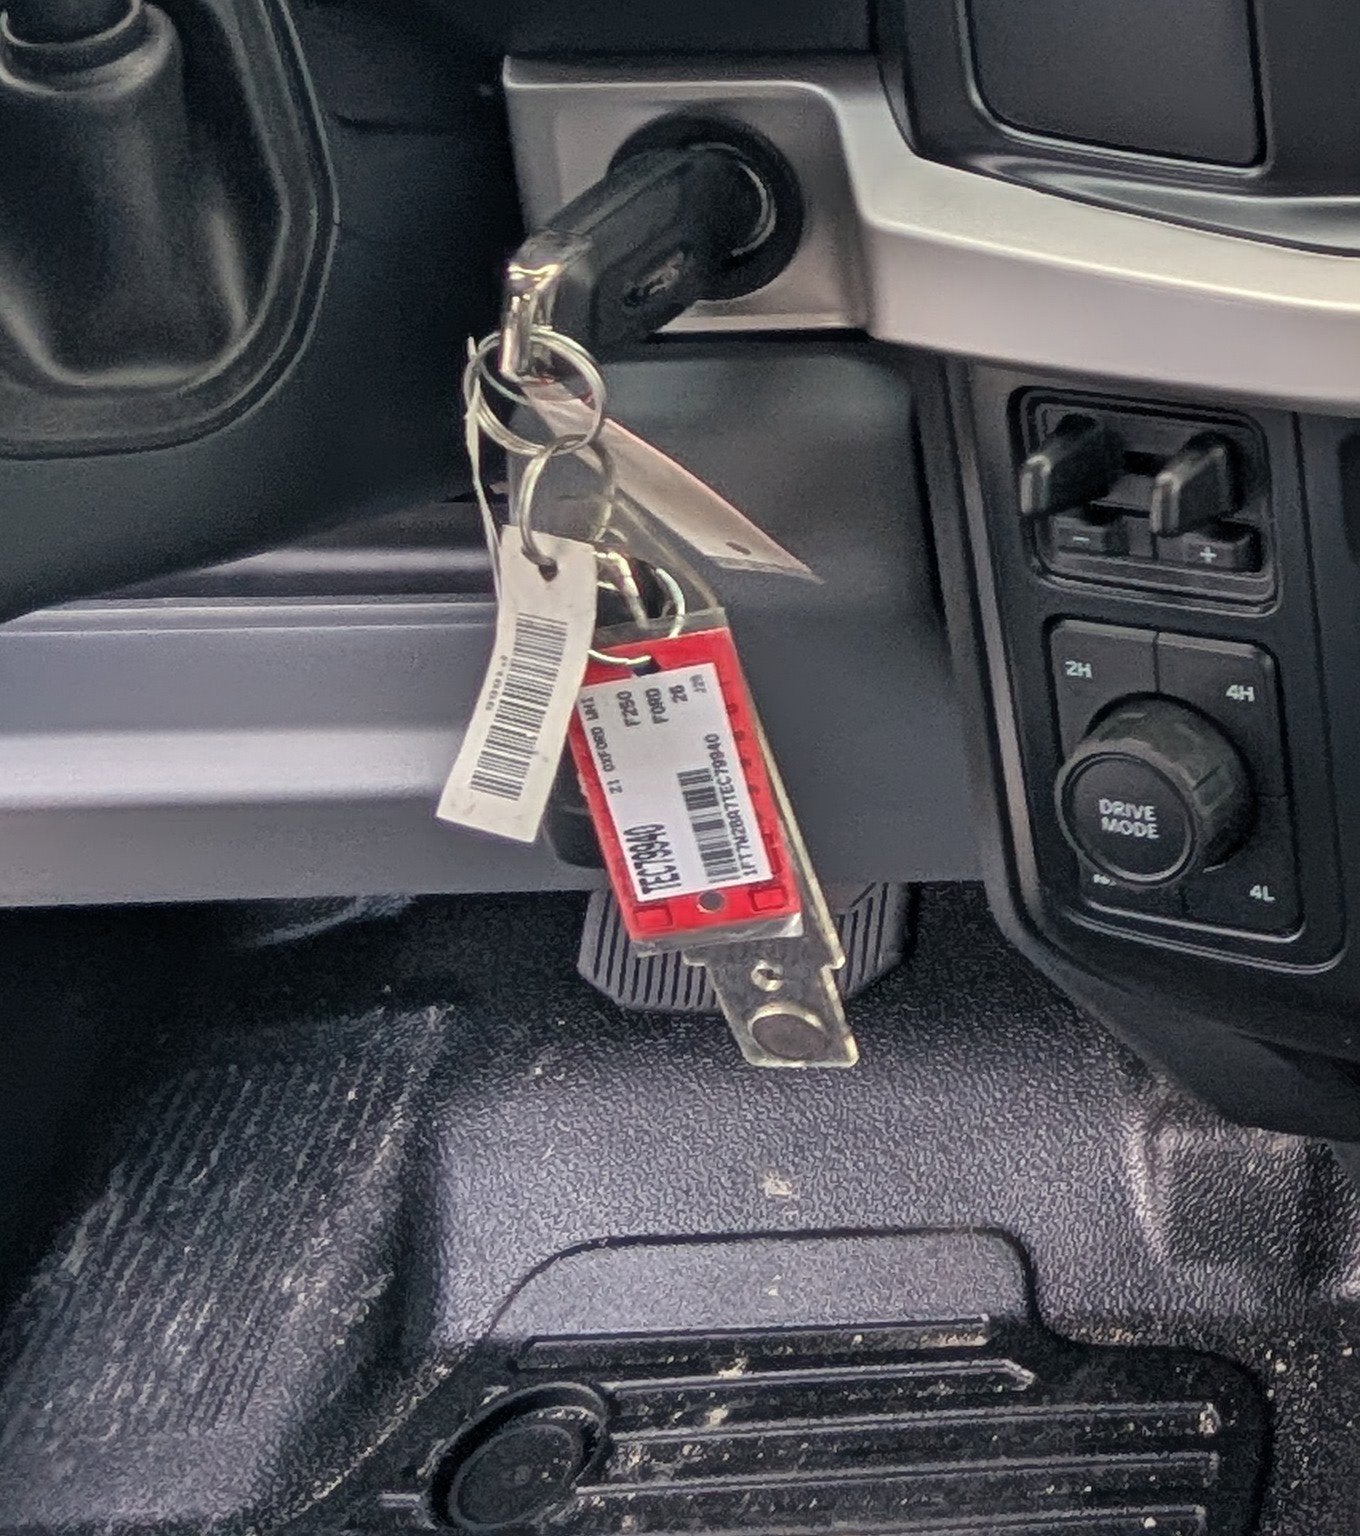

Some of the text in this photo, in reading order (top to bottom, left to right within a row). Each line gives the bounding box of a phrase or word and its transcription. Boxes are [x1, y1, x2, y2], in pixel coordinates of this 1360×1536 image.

[1065, 660, 1093, 679] 2H
[1225, 683, 1255, 703] 4H
[616, 690, 641, 727] F250
[645, 687, 669, 724] FORD
[590, 726, 616, 773] OXFORD
[1098, 798, 1157, 822] DRIVE
[1100, 816, 1160, 840] MODE
[623, 823, 682, 895] TEC79940
[1249, 884, 1276, 902] 4L
